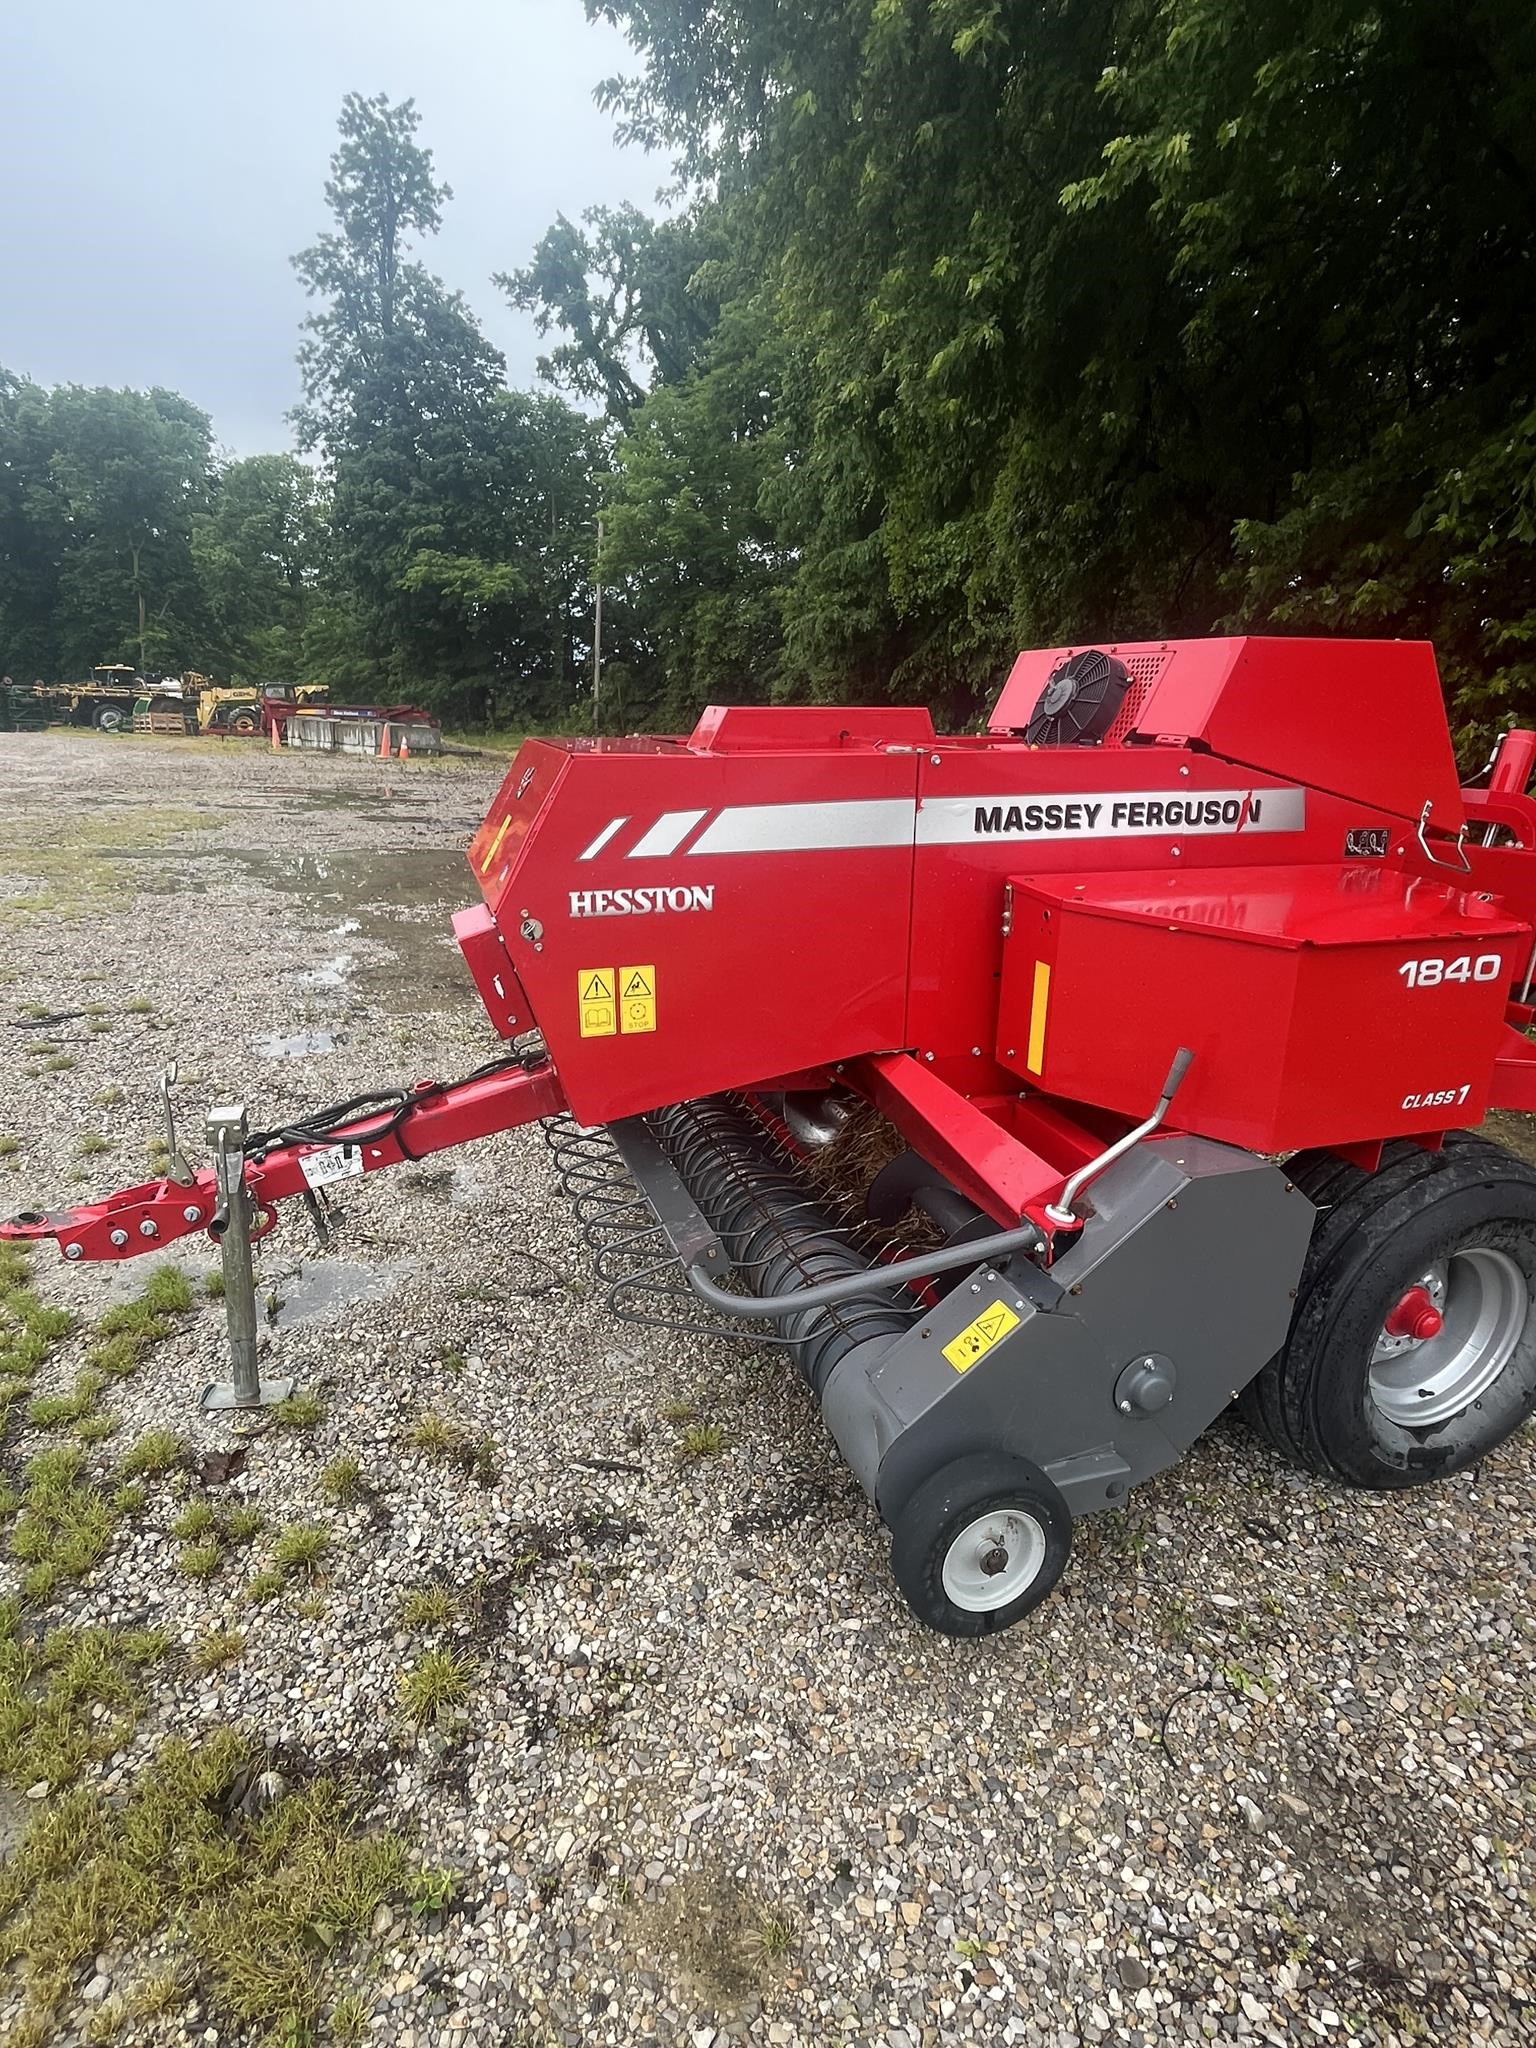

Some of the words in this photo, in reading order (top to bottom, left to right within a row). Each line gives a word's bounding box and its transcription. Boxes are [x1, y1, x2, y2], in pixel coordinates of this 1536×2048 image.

[974, 804, 1101, 834] MASSEY
[1111, 799, 1261, 828] FERGUSON
[569, 885, 714, 917] HESSTON
[1398, 954, 1501, 988] 1840
[628, 1021, 649, 1029] STOP
[1401, 1090, 1456, 1109] CLASS
